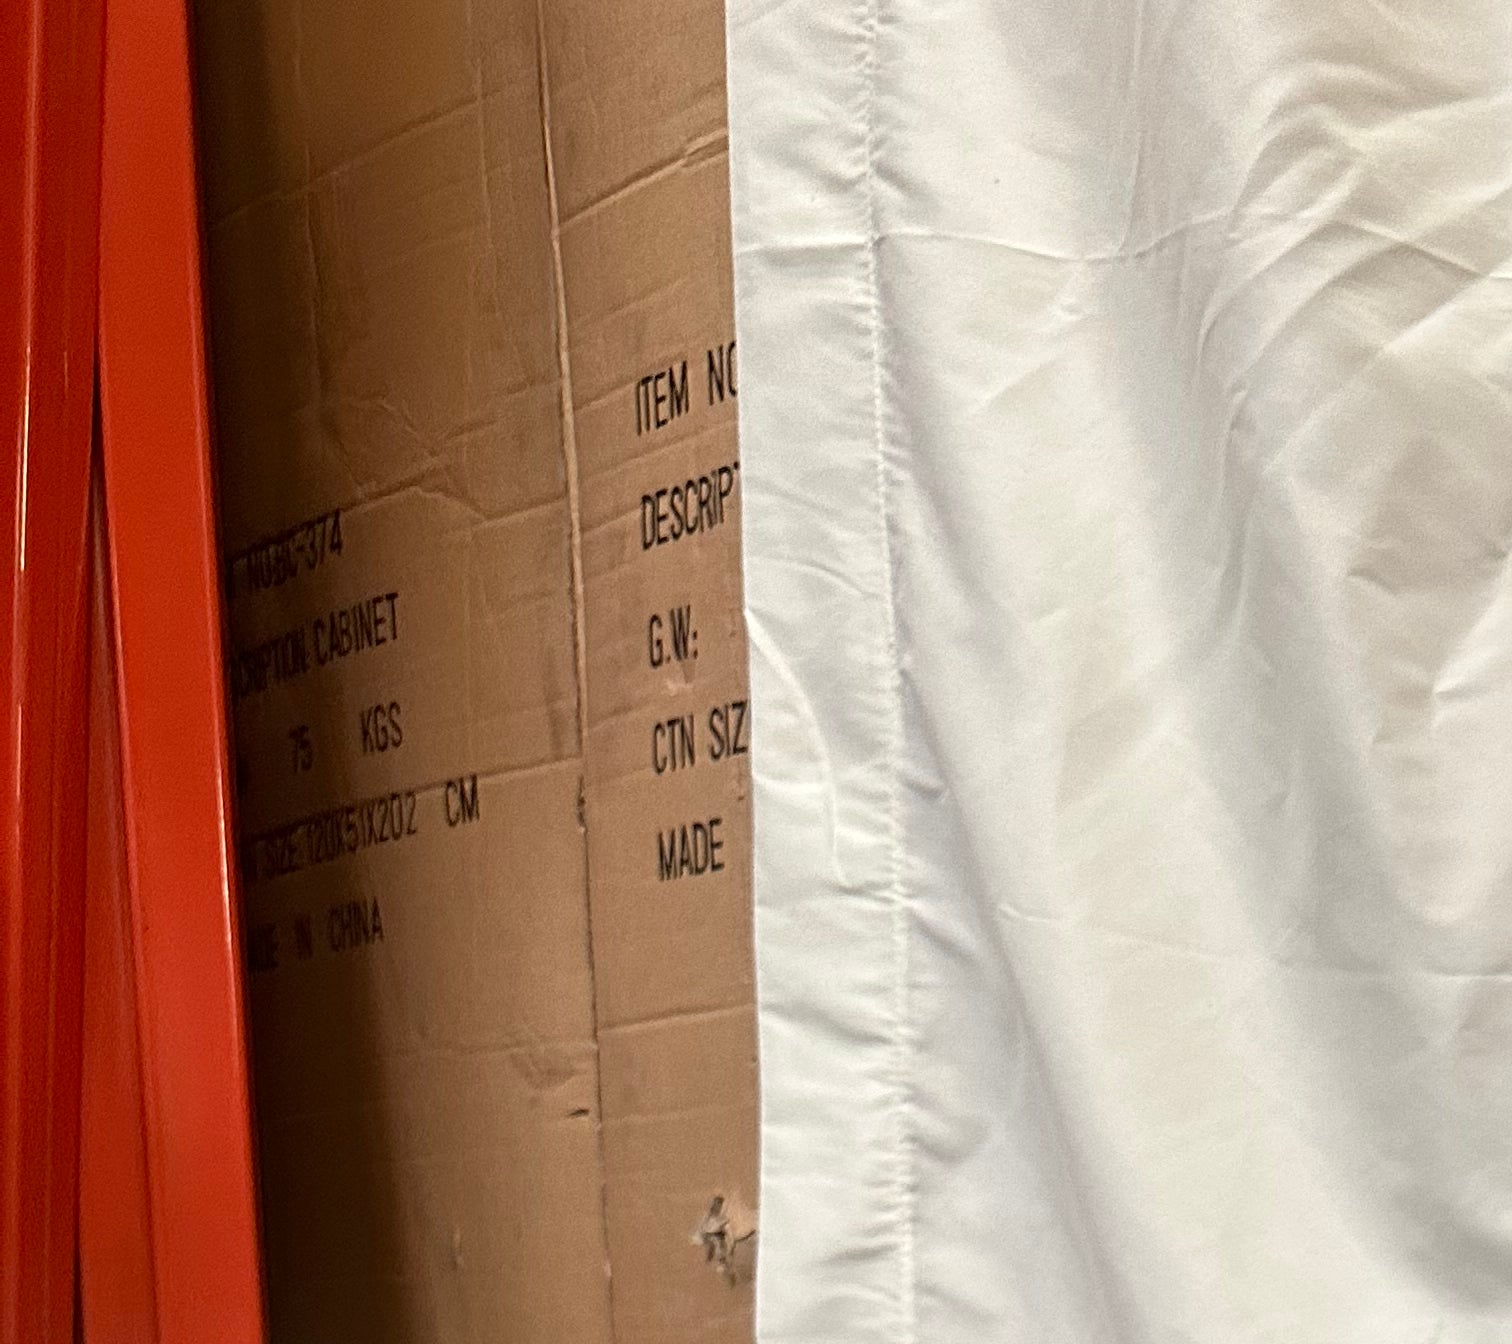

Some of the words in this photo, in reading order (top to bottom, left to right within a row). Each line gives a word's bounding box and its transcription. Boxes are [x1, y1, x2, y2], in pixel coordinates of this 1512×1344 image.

[635, 360, 690, 436] ITEM
[641, 461, 740, 551] DESCRIP
[314, 592, 399, 667] CABINET
[649, 604, 699, 670] G.W:
[359, 701, 404, 754] KGS
[653, 714, 696, 776] CTN
[444, 773, 481, 829] CM
[657, 817, 725, 882] MADE
[327, 896, 385, 953] CHINA
